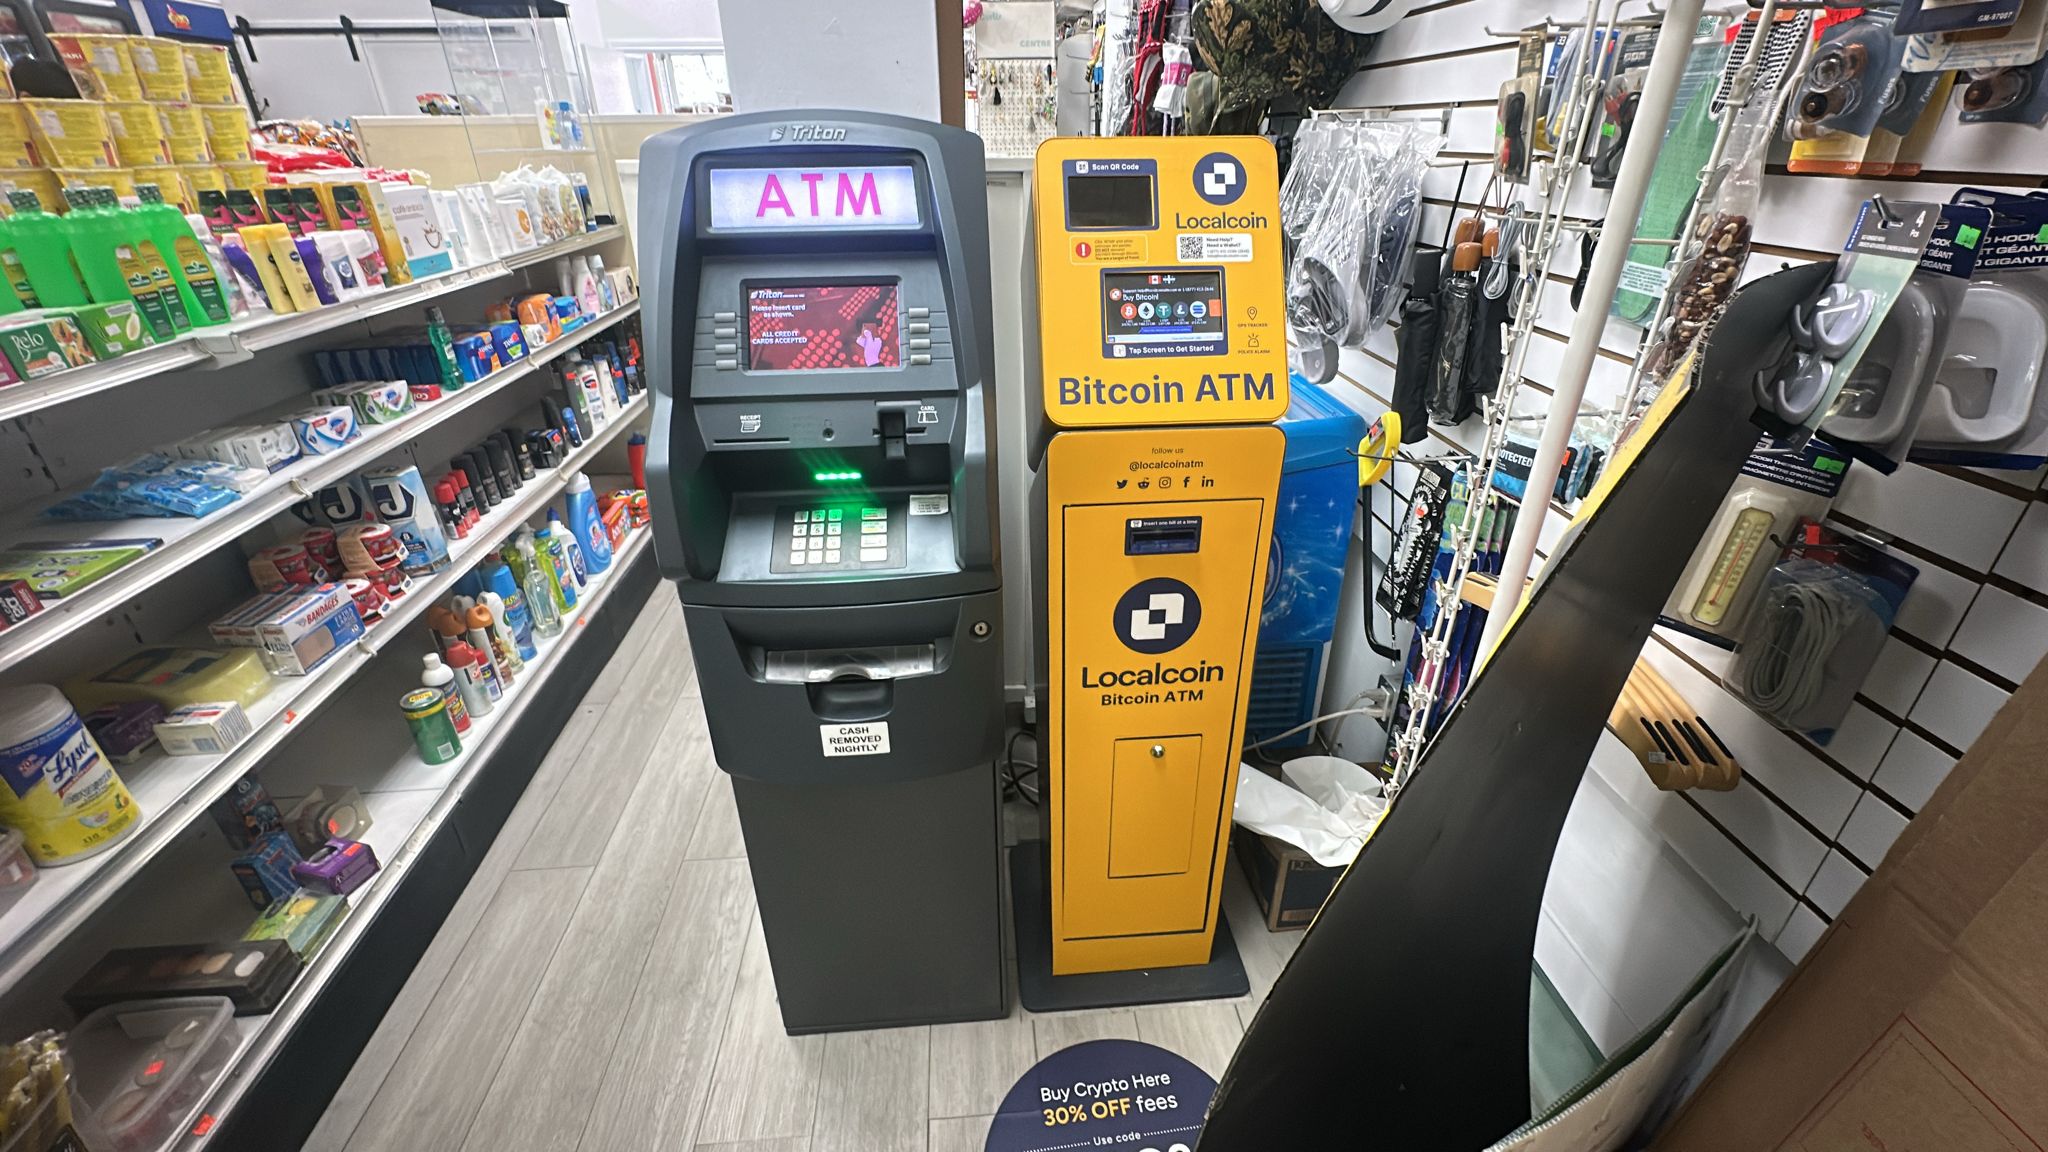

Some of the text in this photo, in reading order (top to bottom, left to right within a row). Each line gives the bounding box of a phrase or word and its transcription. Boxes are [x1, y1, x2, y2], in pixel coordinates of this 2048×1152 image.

[792, 124, 847, 141] Triton
[1092, 163, 1109, 171] Scan
[1121, 163, 1140, 171] Code
[755, 172, 882, 218] ATM
[1175, 211, 1267, 229] Localcoin
[1993, 233, 2040, 244] HOOK
[1995, 244, 2048, 254] GÉANT
[758, 290, 784, 299] Triton
[1122, 294, 1134, 302] Buy
[10, 330, 45, 363] Belo
[1128, 346, 1141, 355] Tap
[1142, 345, 1166, 353] Screen
[1189, 344, 1214, 352] Started
[1059, 372, 1275, 405] Bitcoin ATM
[1129, 460, 1204, 471] @localcoinatm
[1499, 449, 1533, 468] OTECTED
[306, 592, 339, 625] BANDAGES
[1082, 659, 1224, 689] Localcoin
[1101, 689, 1204, 706] Bitcoin ATM
[840, 726, 869, 735] CASH
[829, 735, 882, 745] REMOVED
[834, 744, 879, 753] NIGHTLY
[45, 729, 91, 784] Lysol
[1040, 1073, 1171, 1103] Buy Crypto Here
[1043, 1094, 1178, 1127] 30% OFF fees
[1093, 1131, 1141, 1146] Use code
